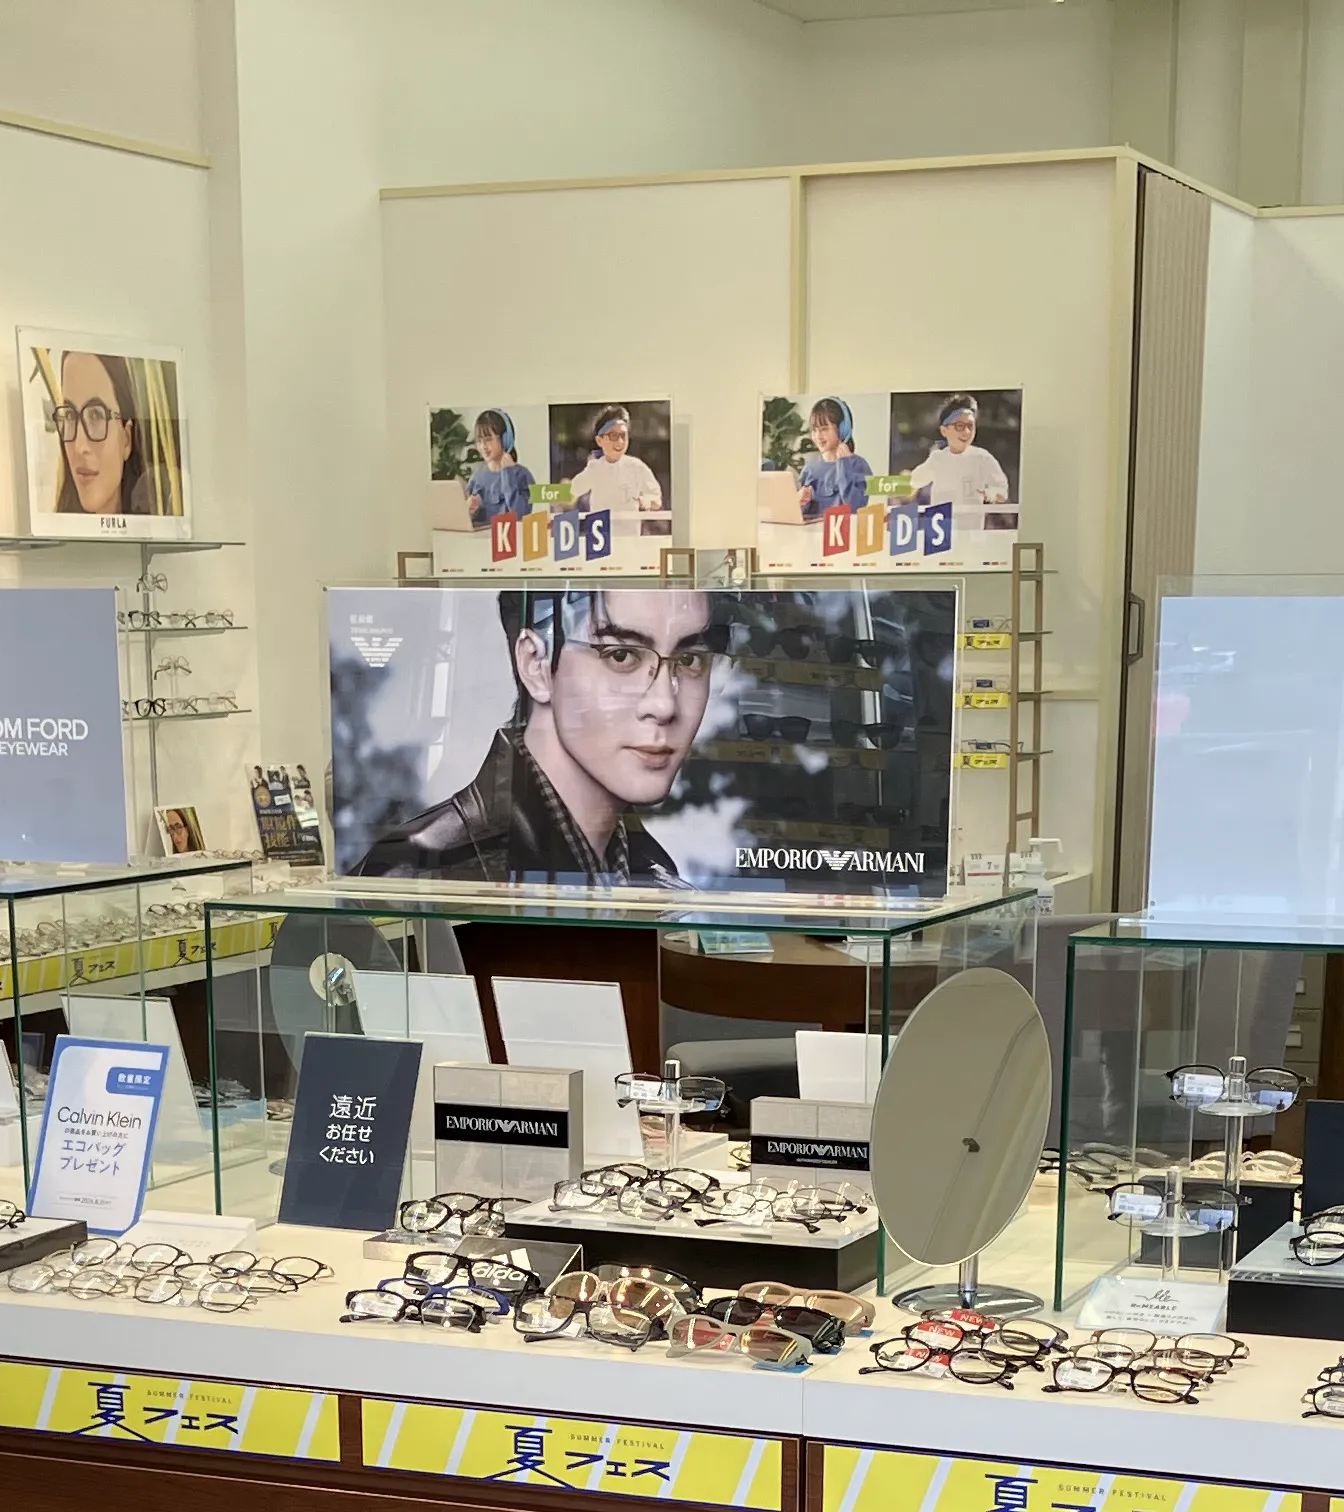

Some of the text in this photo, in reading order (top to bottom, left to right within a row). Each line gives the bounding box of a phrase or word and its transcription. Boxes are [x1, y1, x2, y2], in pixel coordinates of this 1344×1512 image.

[541, 486, 560, 500] for
[878, 478, 899, 493] for
[100, 517, 127, 528] FURLA
[829, 512, 945, 547] KIDS
[497, 520, 605, 553] KIDS
[26, 718, 89, 740] FORD
[735, 847, 925, 873] EMPORIO ARMANI
[328, 1094, 377, 1121] 遠近
[58, 1106, 142, 1130] Calvin Klein
[446, 1115, 558, 1137] EMPORIO ARMANI
[326, 1124, 373, 1142] お任せ
[62, 1139, 126, 1158] エコバッグ
[319, 1147, 374, 1165] ください
[767, 1141, 868, 1159] EMPORIO ARMANI
[60, 1156, 120, 1176] プレゼント
[928, 1325, 956, 1338] NEW
[147, 1389, 233, 1404] SUMMER FESTIVAL
[71, 1382, 239, 1443] 夏フェス
[570, 1434, 665, 1450] SUMMER FESTIVAL
[484, 1425, 671, 1489] 夏フェス
[1058, 1484, 1167, 1501] SUMMER FESTIVAL
